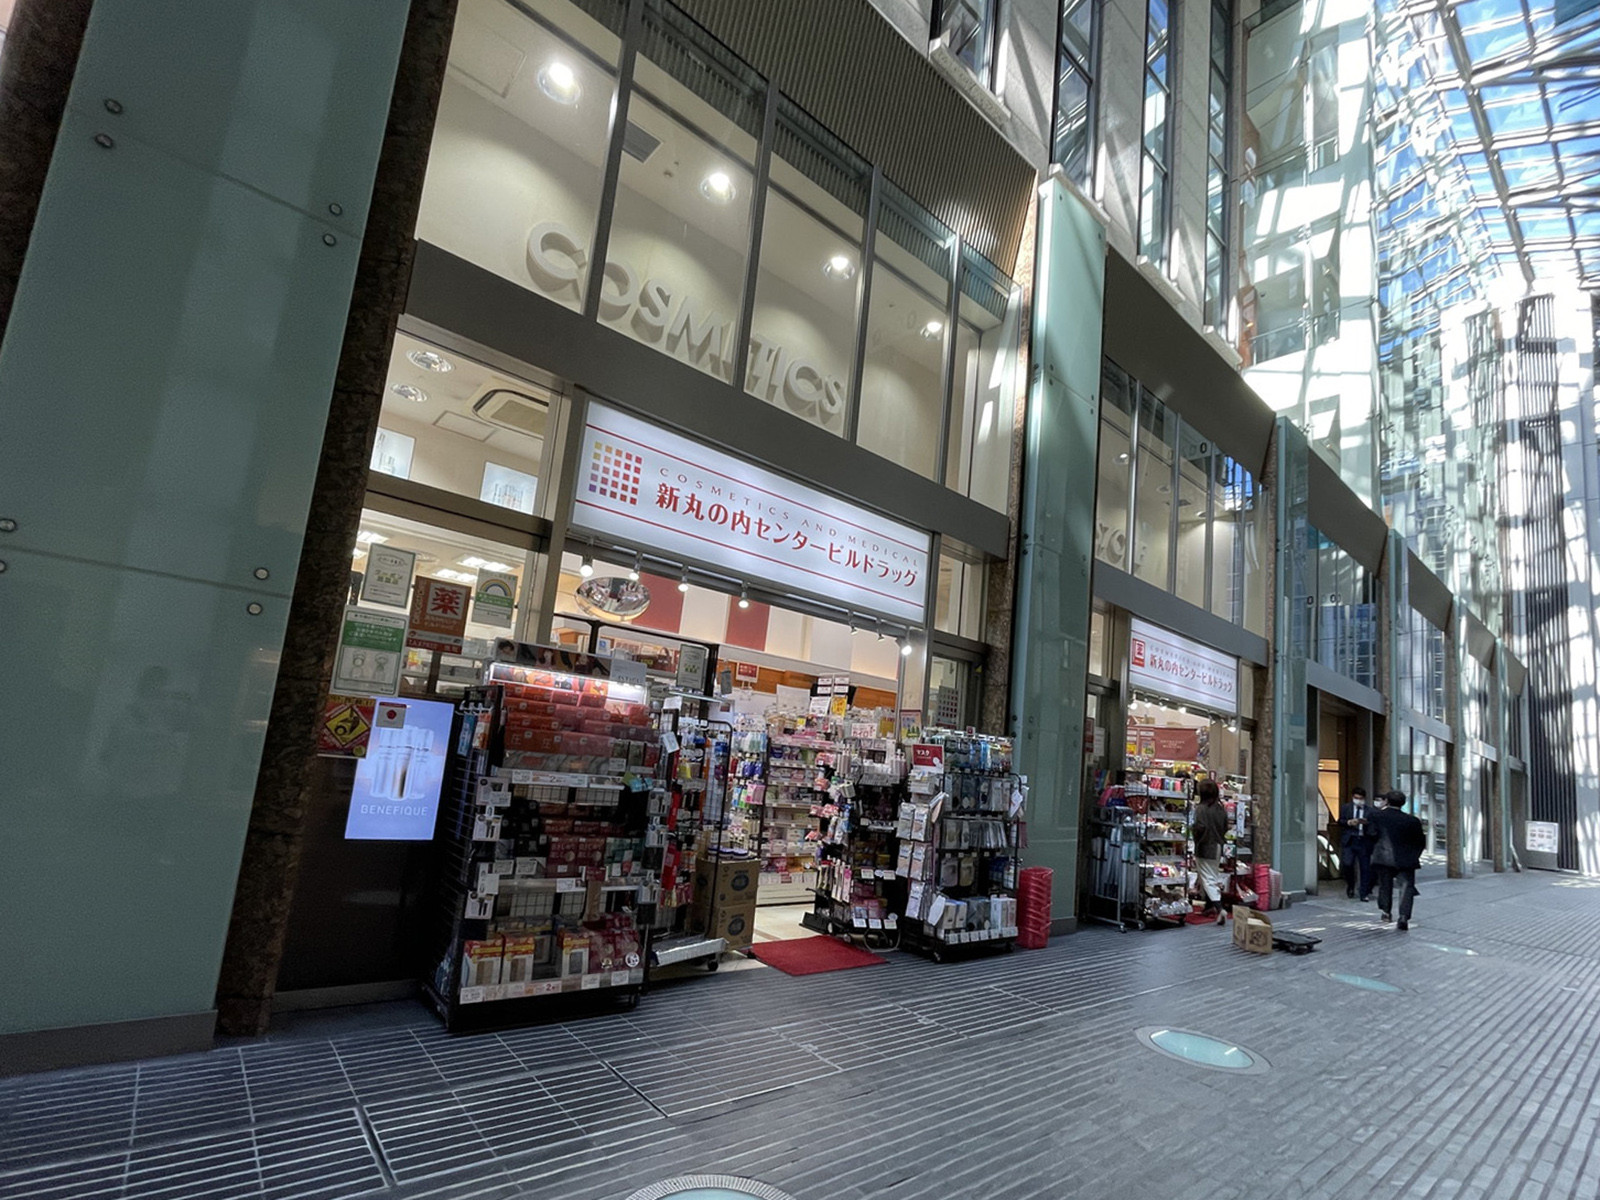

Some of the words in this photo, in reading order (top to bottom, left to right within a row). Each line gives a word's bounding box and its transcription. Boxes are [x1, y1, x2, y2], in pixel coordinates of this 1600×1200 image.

[655, 483, 918, 588] 新丸の内センタービルドラッグ
[659, 466, 791, 520] COSMETICS
[802, 519, 838, 537] AND
[847, 534, 918, 567] MEDICAL
[431, 587, 462, 615] 薬
[1150, 653, 1233, 693] 新丸の内センタービルドラッグ
[361, 804, 428, 817] BENEFIQUE
